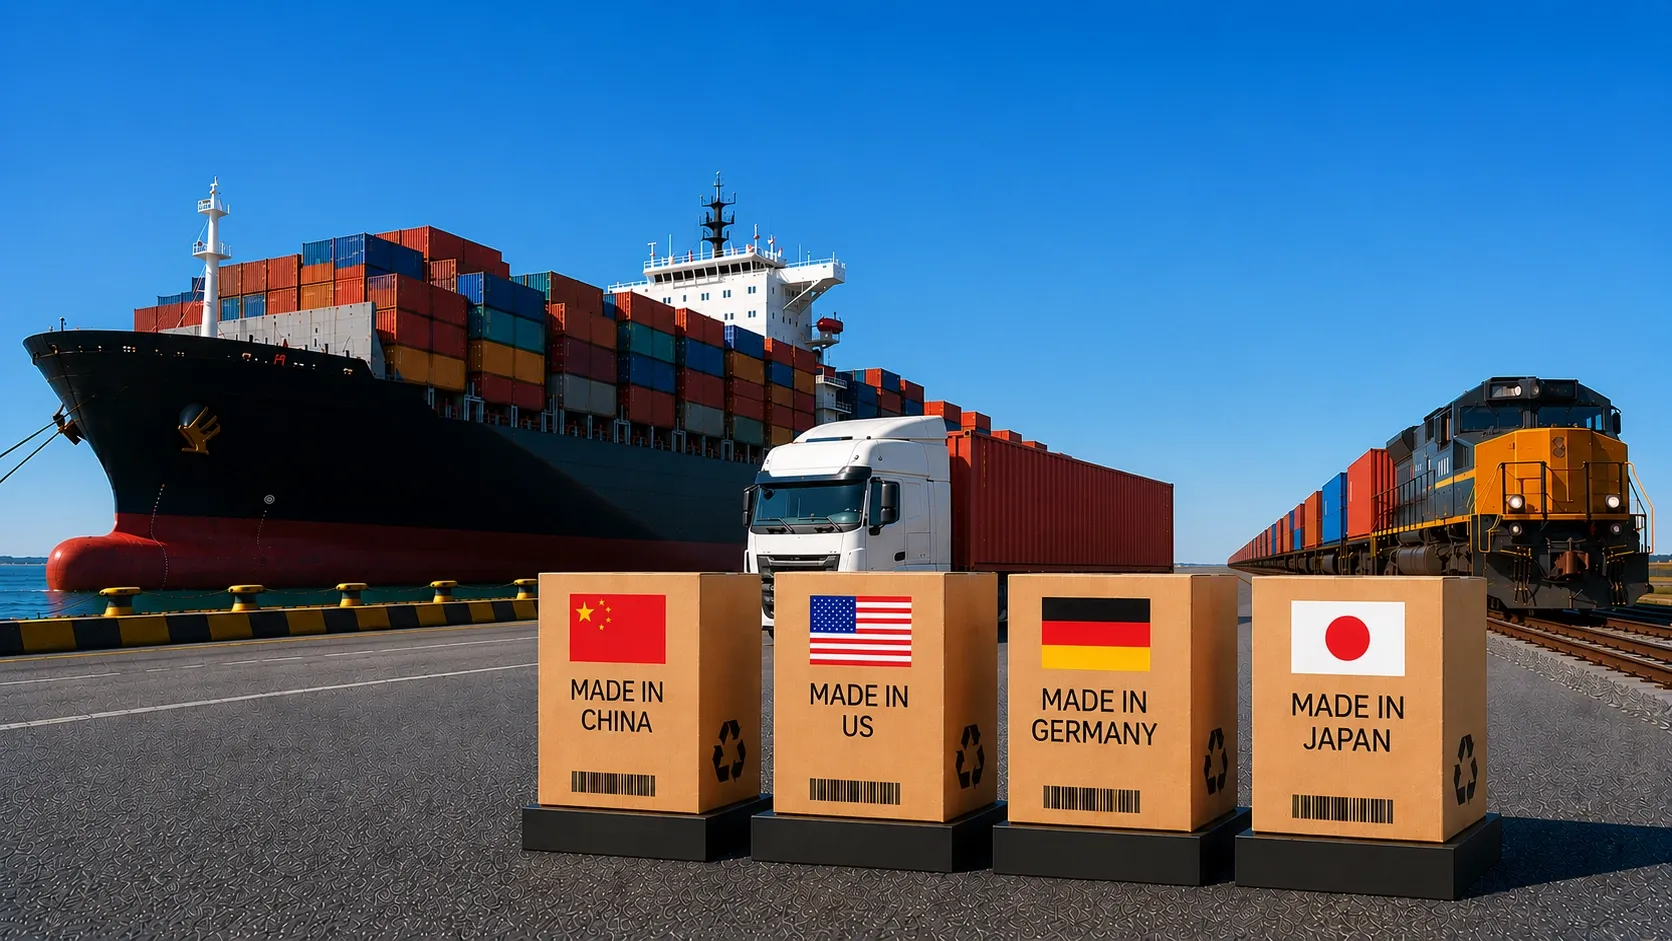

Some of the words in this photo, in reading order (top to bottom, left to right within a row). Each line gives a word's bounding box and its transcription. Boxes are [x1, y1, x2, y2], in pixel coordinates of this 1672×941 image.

[571, 678, 635, 702] MADE
[642, 680, 663, 703] IN
[810, 682, 878, 707] MADE
[885, 684, 908, 708] IN
[1042, 687, 1115, 712] MADE
[1122, 690, 1147, 714] IN
[1292, 692, 1369, 719] MADE
[1378, 695, 1404, 720] IN
[581, 708, 653, 733] CHINA
[842, 714, 874, 738] US
[1031, 718, 1158, 746] GERMANY
[1303, 726, 1391, 753] JAPAN
